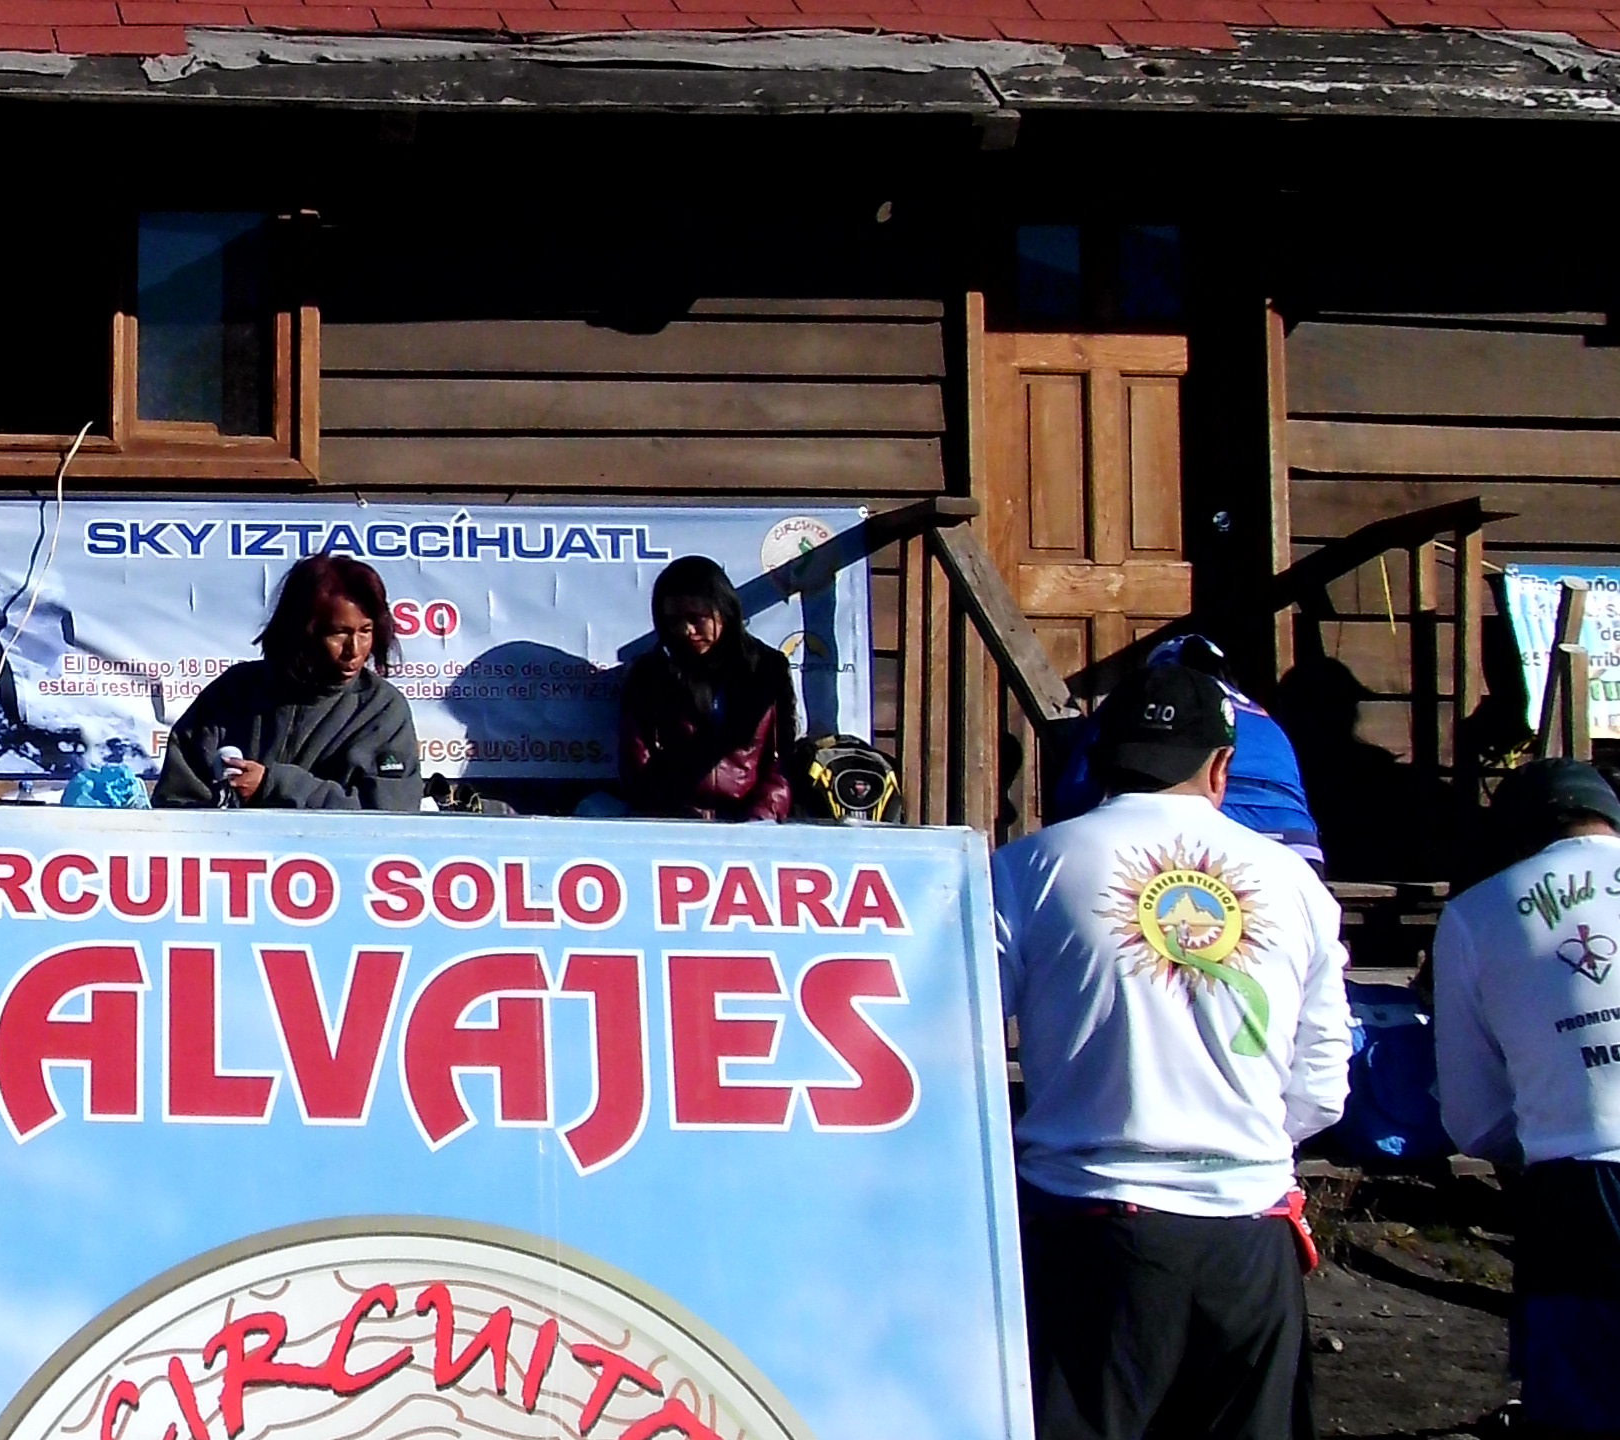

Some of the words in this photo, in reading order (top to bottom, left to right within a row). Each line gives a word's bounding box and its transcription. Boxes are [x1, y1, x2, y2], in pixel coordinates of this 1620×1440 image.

[85, 520, 217, 557] SKY
[230, 511, 670, 560] IZTACCÍHUATL
[774, 521, 828, 542] CIRCUITO
[392, 601, 459, 637] SO
[64, 655, 81, 672] El
[88, 656, 171, 678] Domingo
[178, 659, 198, 674] 18
[443, 660, 465, 676] de
[470, 660, 514, 677] Paso
[521, 661, 542, 677] de
[38, 677, 96, 693] estará
[102, 678, 202, 699] restringido
[506, 682, 533, 698] del
[582, 682, 623, 698] IZTA
[371, 861, 622, 926] SOLO
[658, 867, 902, 929] PARA
[1517, 871, 1595, 930] Wild
[1554, 1006, 1620, 1033] PROMOV
